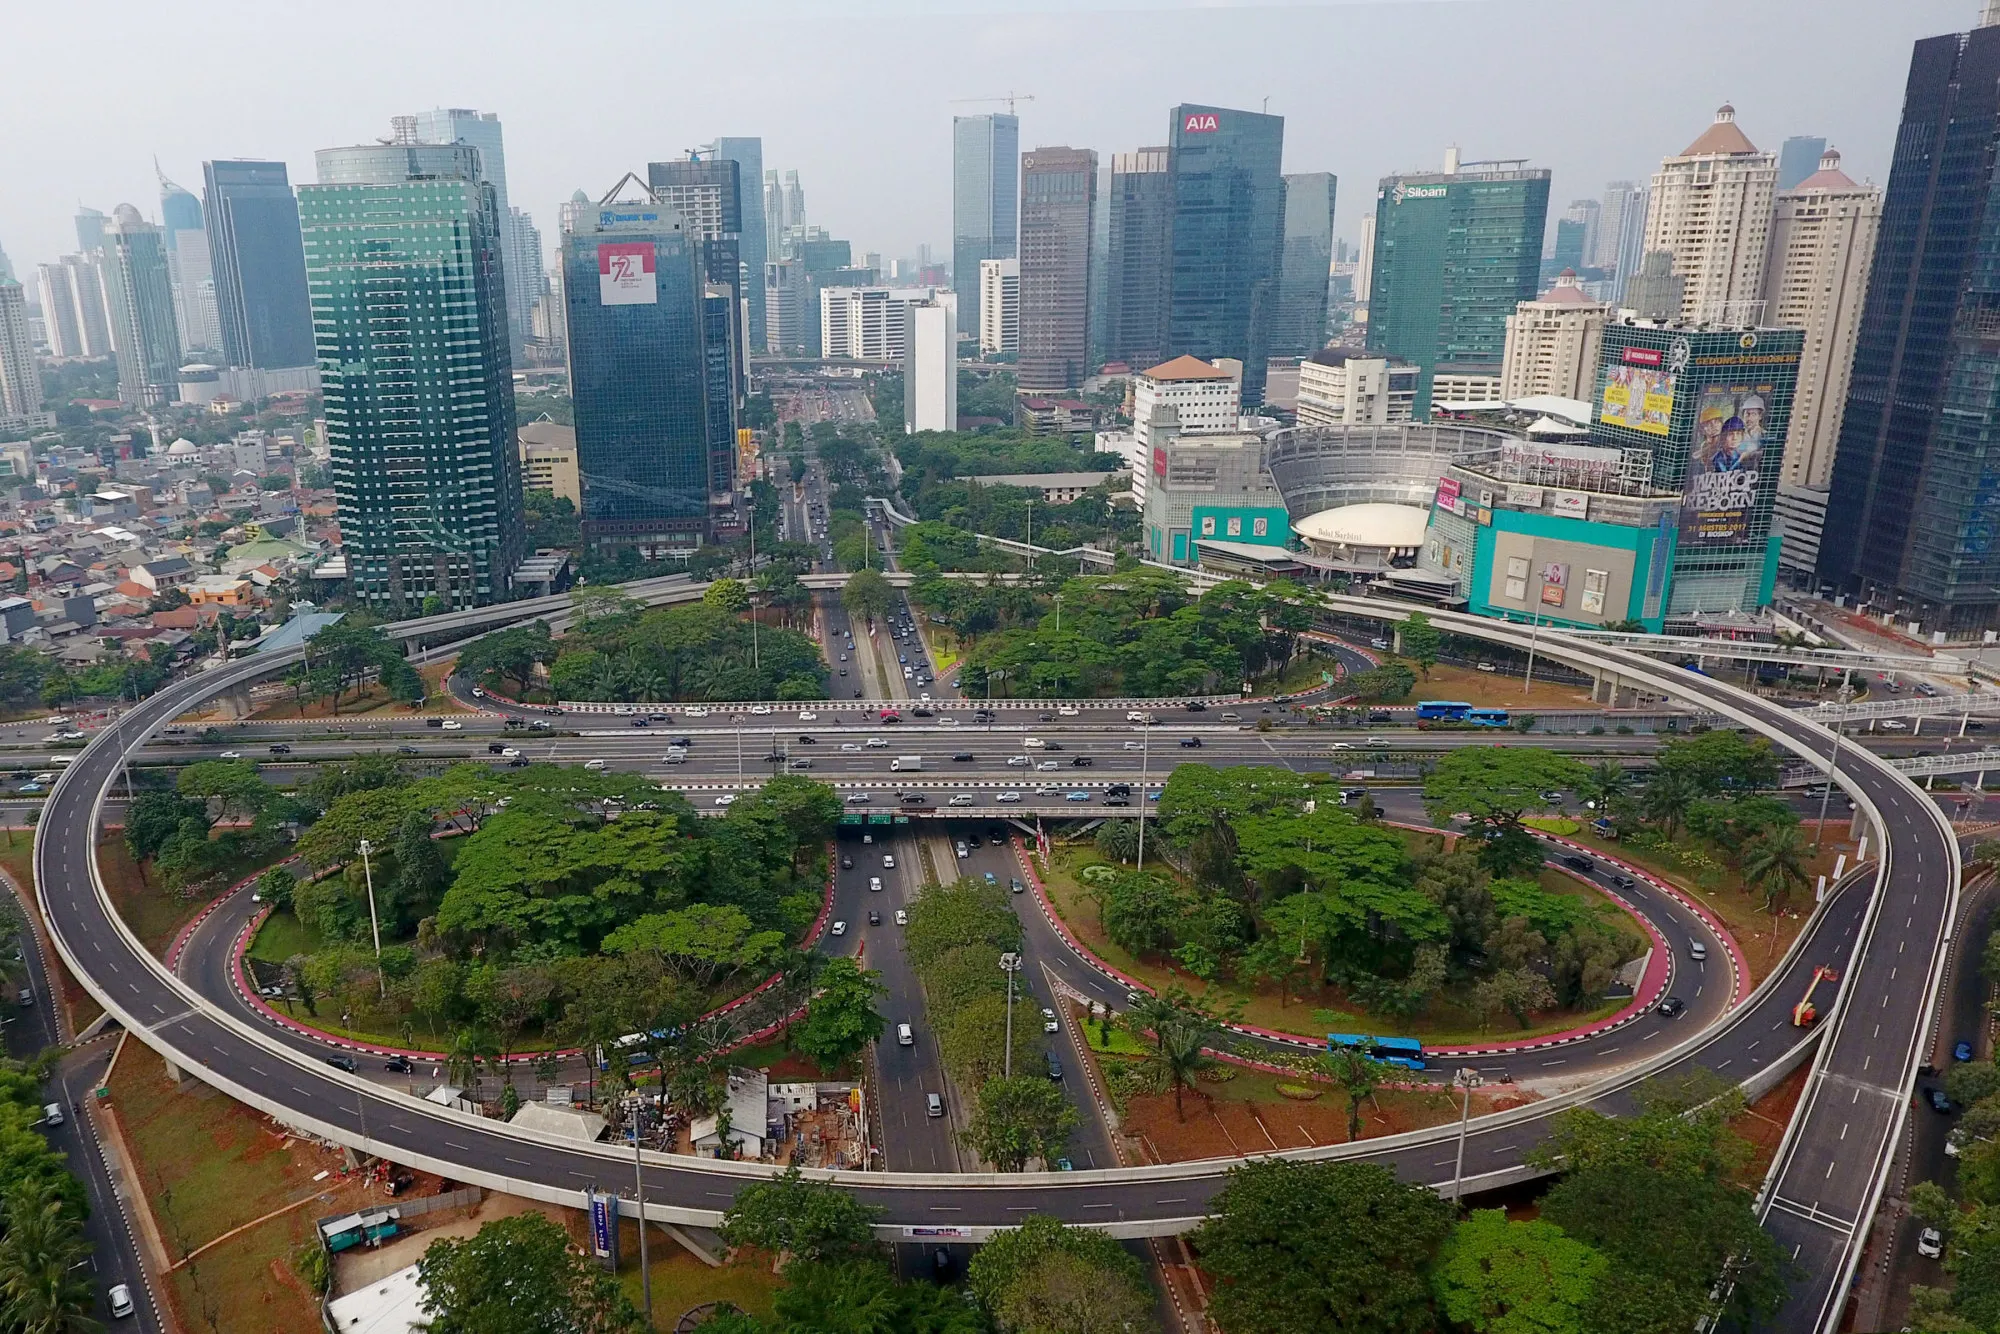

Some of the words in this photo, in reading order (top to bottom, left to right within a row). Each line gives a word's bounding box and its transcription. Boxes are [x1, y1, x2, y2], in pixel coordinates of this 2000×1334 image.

[1186, 116, 1217, 130] AIA
[1407, 187, 1447, 198] Siloam
[612, 256, 635, 282] 72
[1696, 356, 1737, 365] GEDUNG
[1739, 355, 1783, 364] VETERAN
[1501, 446, 1539, 464] Plaza
[1542, 449, 1618, 474] Semanggi
[1692, 470, 1759, 492] WARKOP
[1686, 490, 1757, 511] REBORN
[1699, 524, 1727, 532] AGUSTUS
[1729, 523, 1746, 531] 2017
